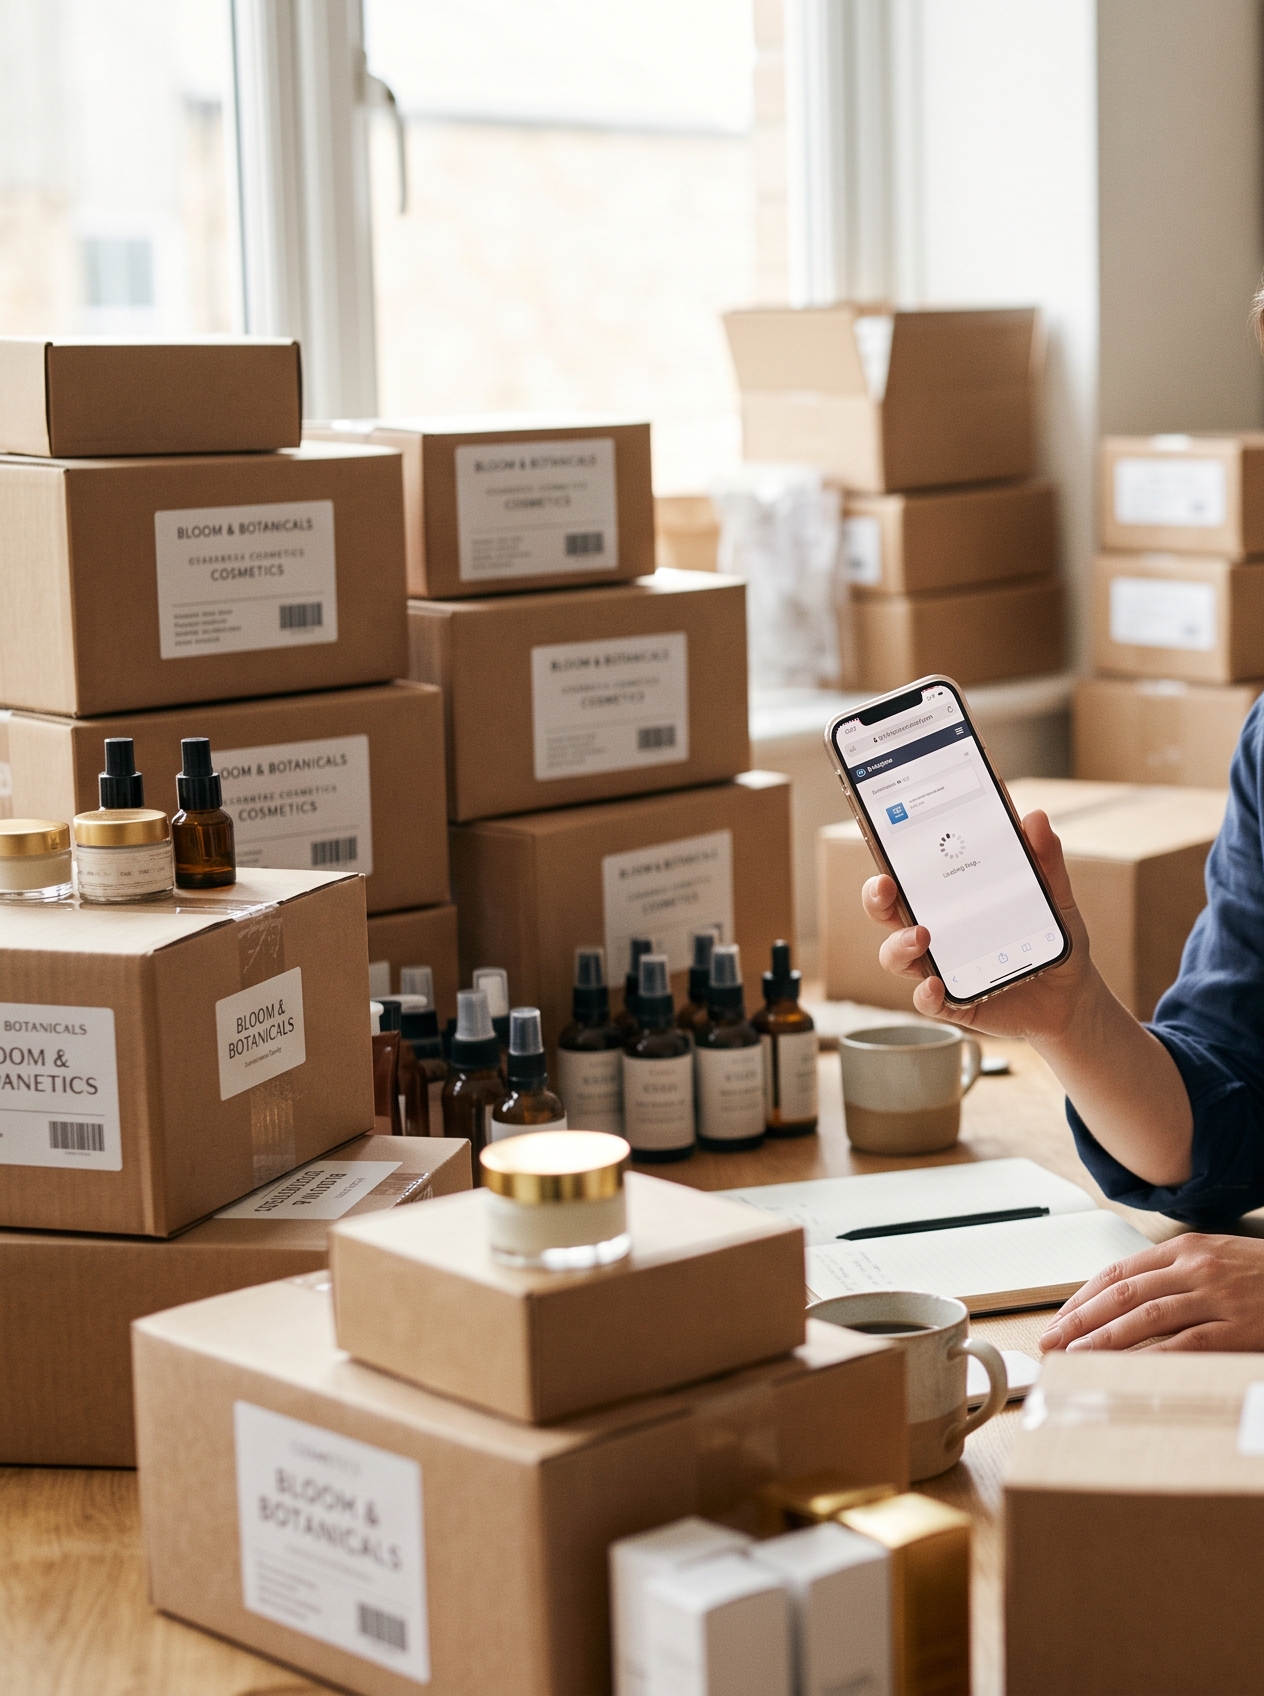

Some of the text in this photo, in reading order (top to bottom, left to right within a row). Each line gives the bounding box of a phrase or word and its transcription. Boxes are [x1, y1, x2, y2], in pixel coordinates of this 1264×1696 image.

[176, 517, 314, 540] BLOOM & BOTANICALS
[210, 563, 285, 582] COSMETICS
[220, 753, 348, 781] OOM & BOTANICALS
[238, 800, 318, 823] COSMETICS
[236, 998, 286, 1034] BLOOM &
[4, 1020, 87, 1036] BOTANICALS
[228, 1016, 294, 1060] BOTANICALS
[53, 1048, 70, 1069] &
[0, 1073, 99, 1096] ANETICS
[275, 1466, 358, 1519] BLOOM
